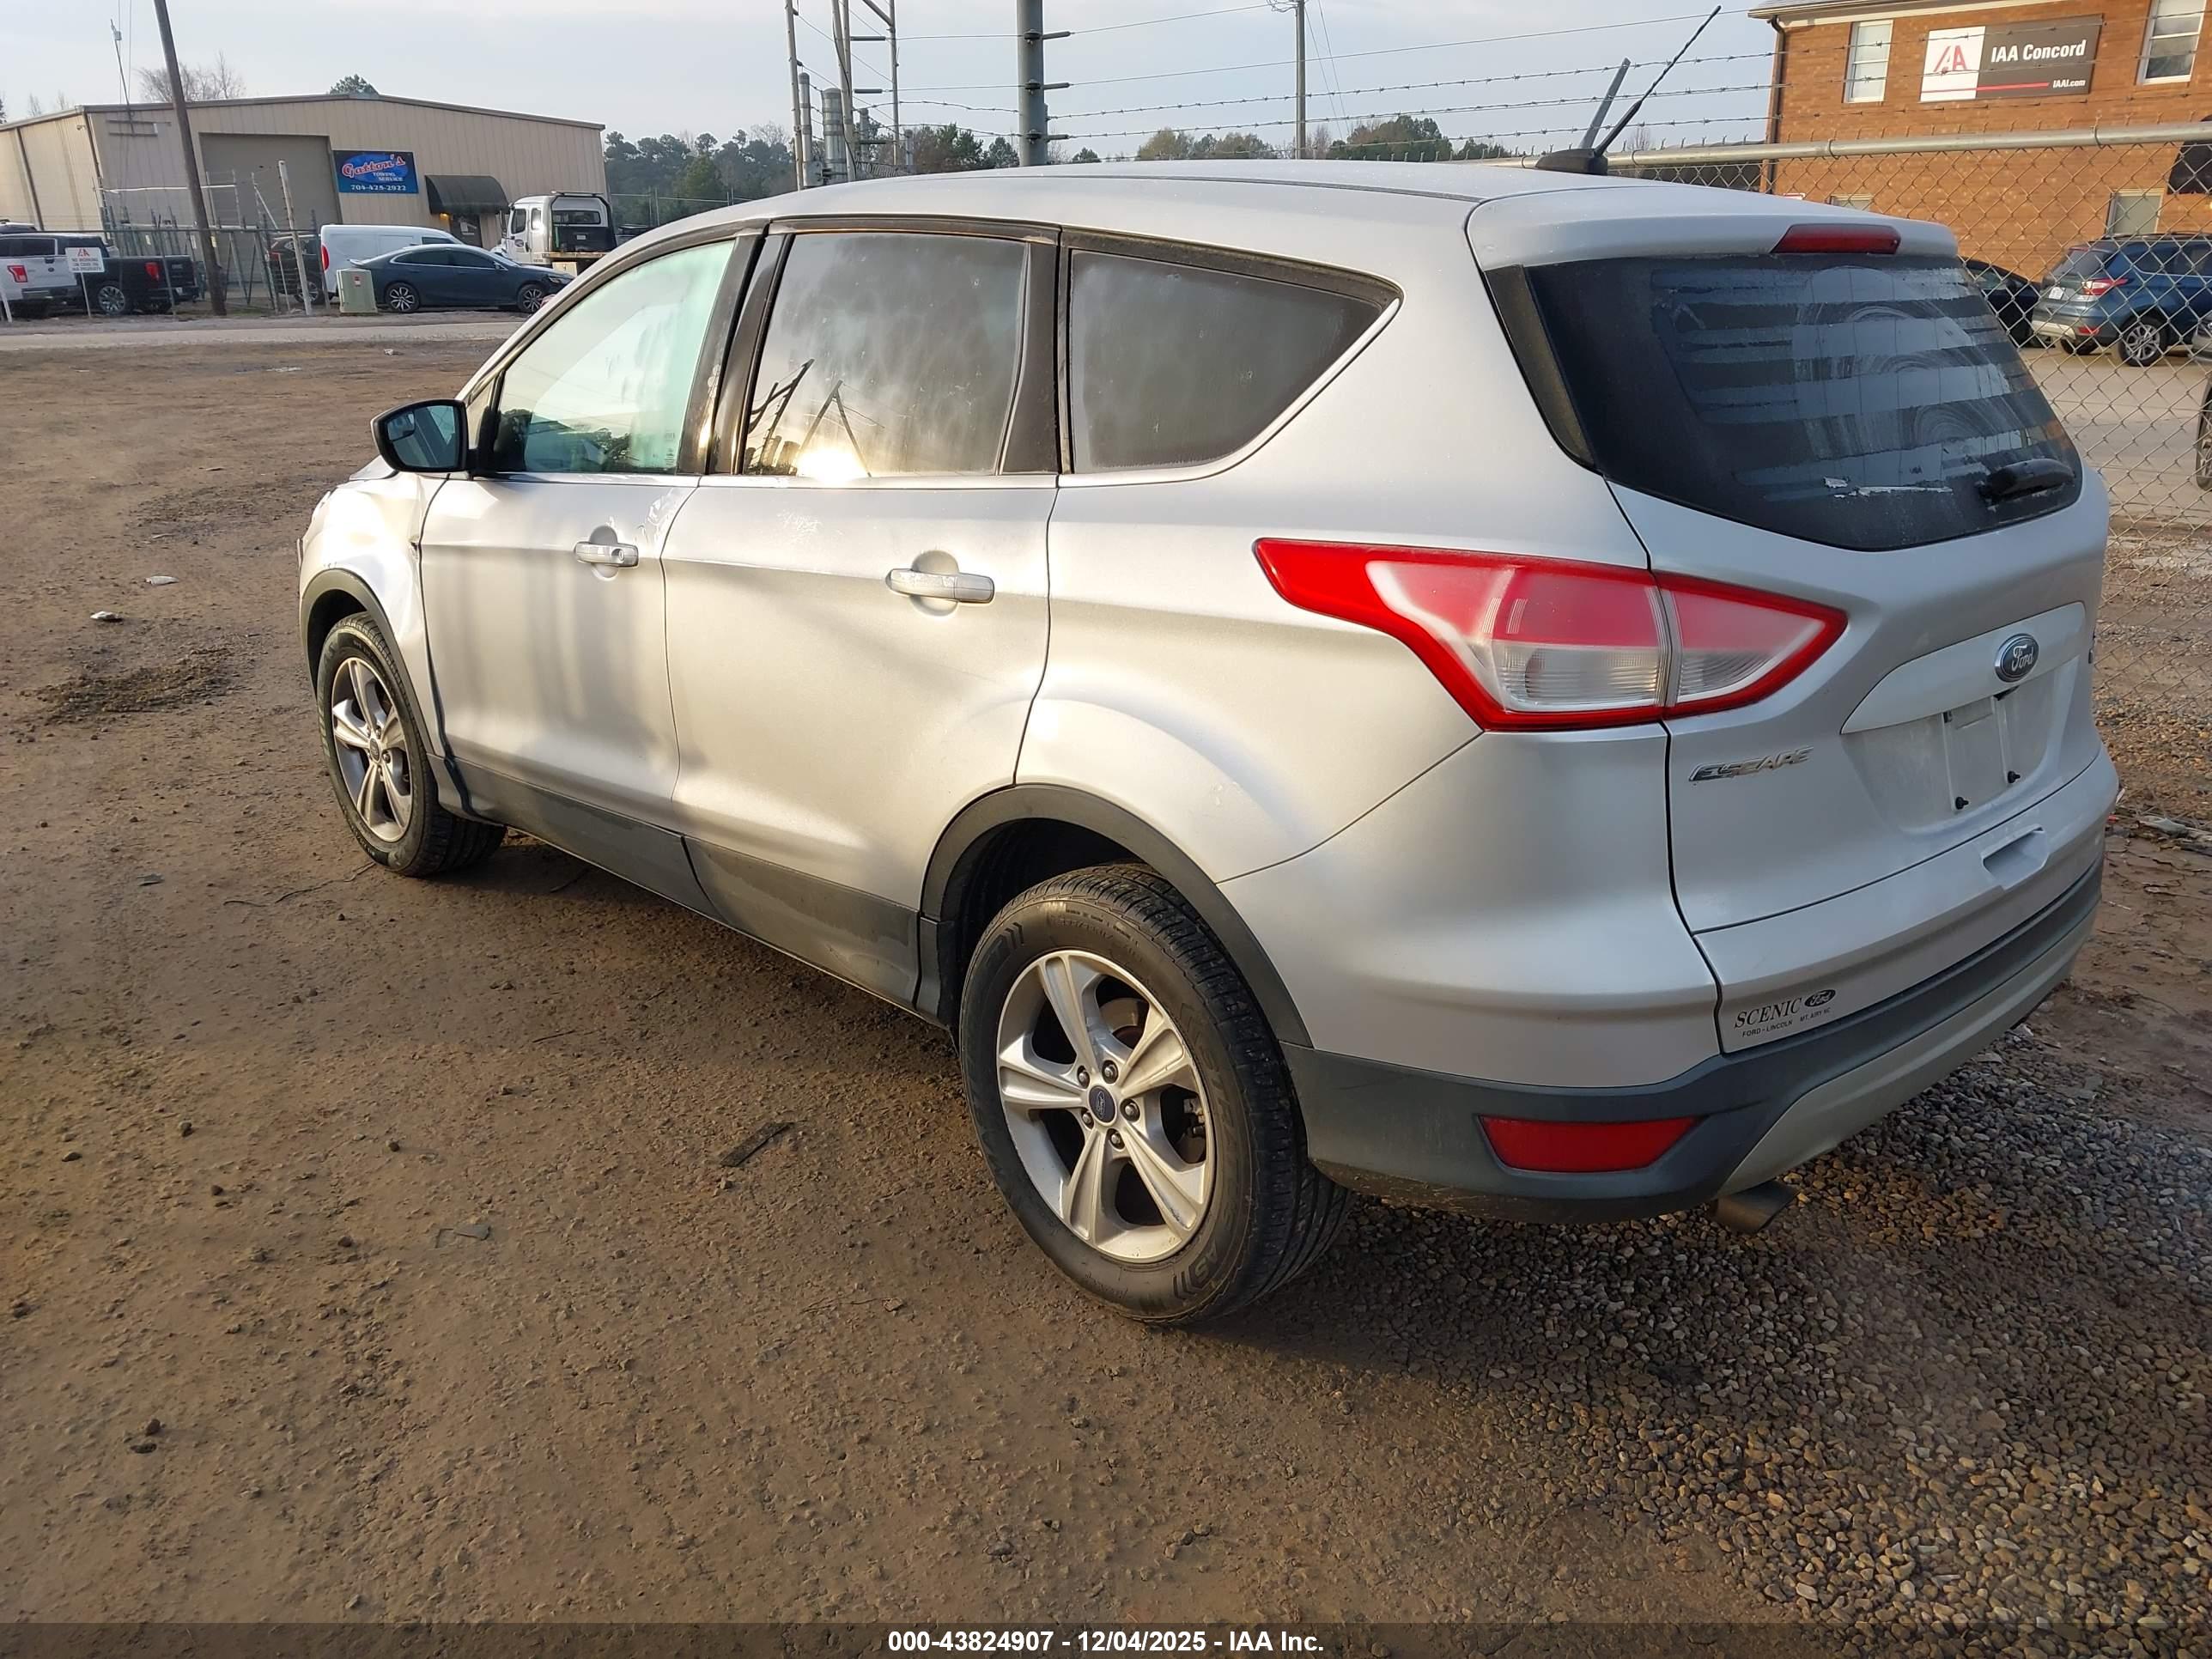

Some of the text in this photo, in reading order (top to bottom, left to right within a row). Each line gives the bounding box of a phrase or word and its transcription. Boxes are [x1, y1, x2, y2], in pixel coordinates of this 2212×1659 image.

[1990, 40, 2087, 63] IAA Concord
[2052, 79, 2086, 88] IAAI.com
[1689, 745, 1814, 782] ESCAPE
[1735, 998, 1802, 1029] SCENIC
[1742, 1027, 1761, 1037] FORD
[1766, 1019, 1793, 1032] LINCOLN
